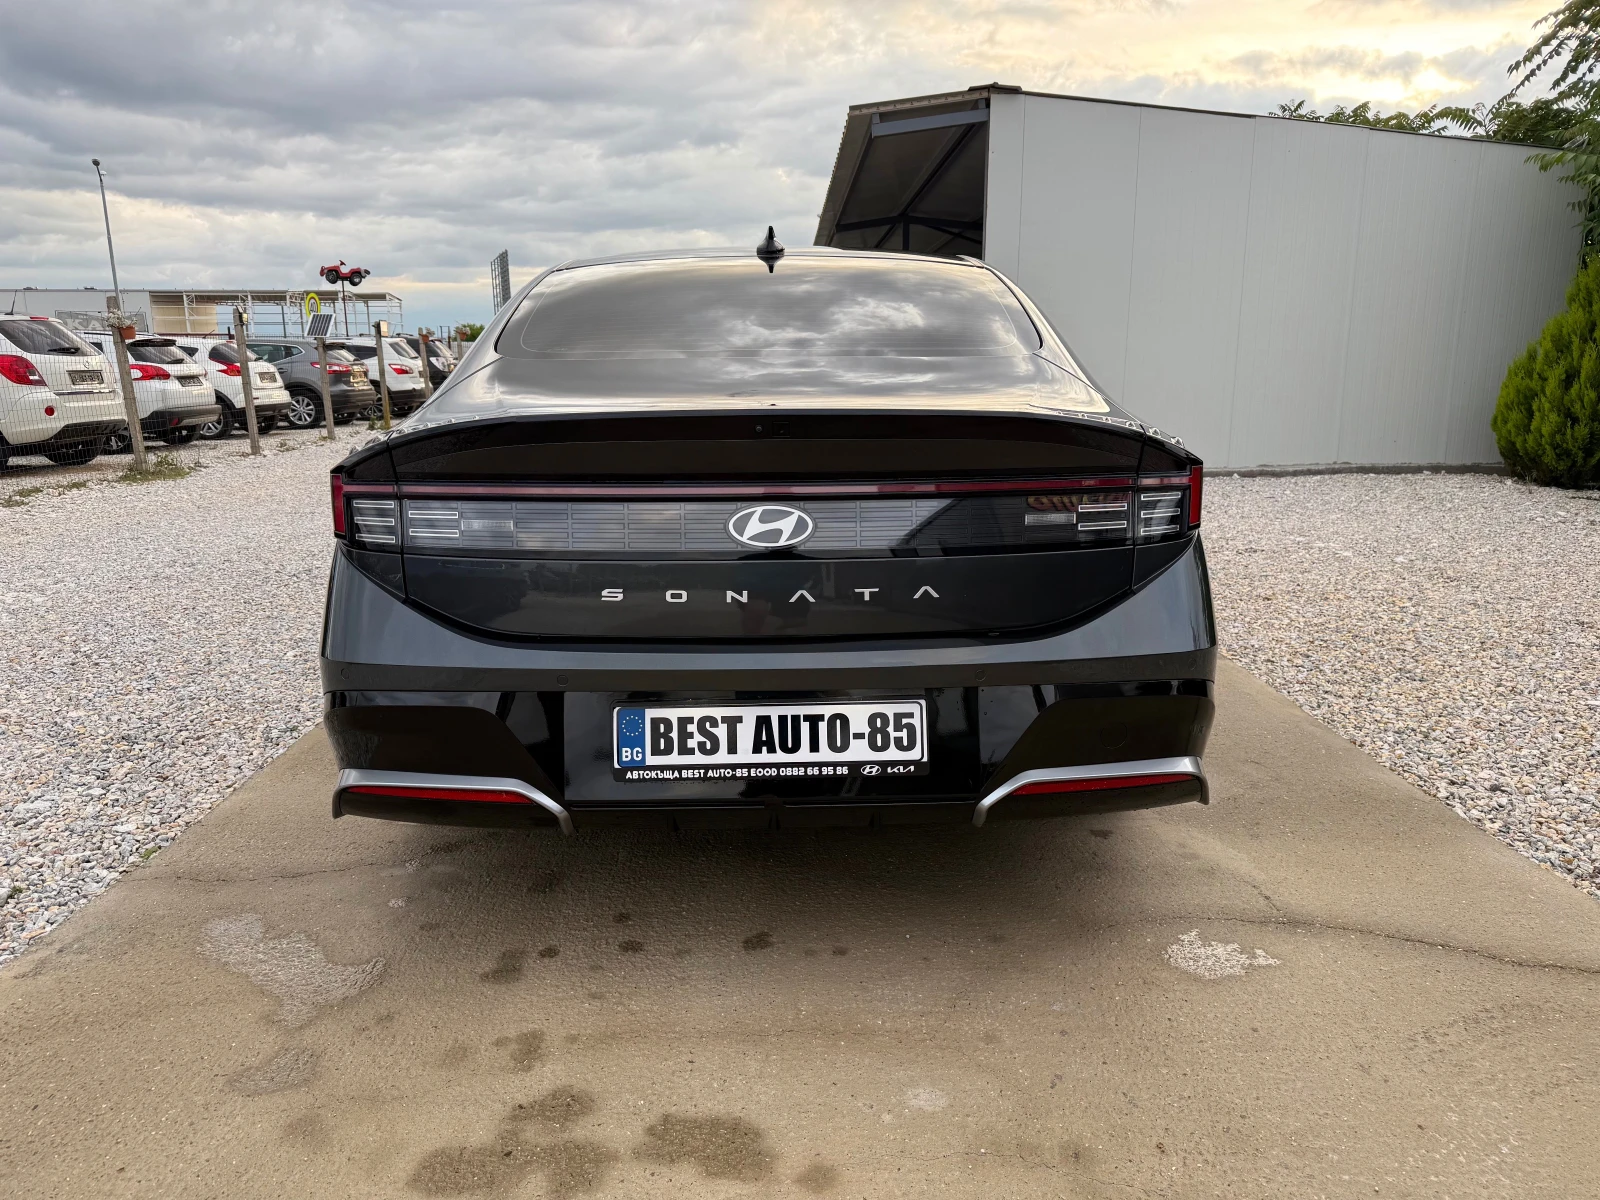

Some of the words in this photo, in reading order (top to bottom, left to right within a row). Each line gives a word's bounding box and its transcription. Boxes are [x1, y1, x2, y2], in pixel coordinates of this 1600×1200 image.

[601, 586, 940, 602] SONATA
[650, 715, 743, 756] BEST
[751, 712, 917, 755] AUTO-85
[621, 747, 643, 761] BG
[681, 769, 705, 778] BEST
[707, 768, 749, 777] AUTO-85
[780, 767, 805, 776] 0882
[807, 767, 819, 775] 66
[821, 767, 834, 775] 95
[836, 766, 849, 775] 86
